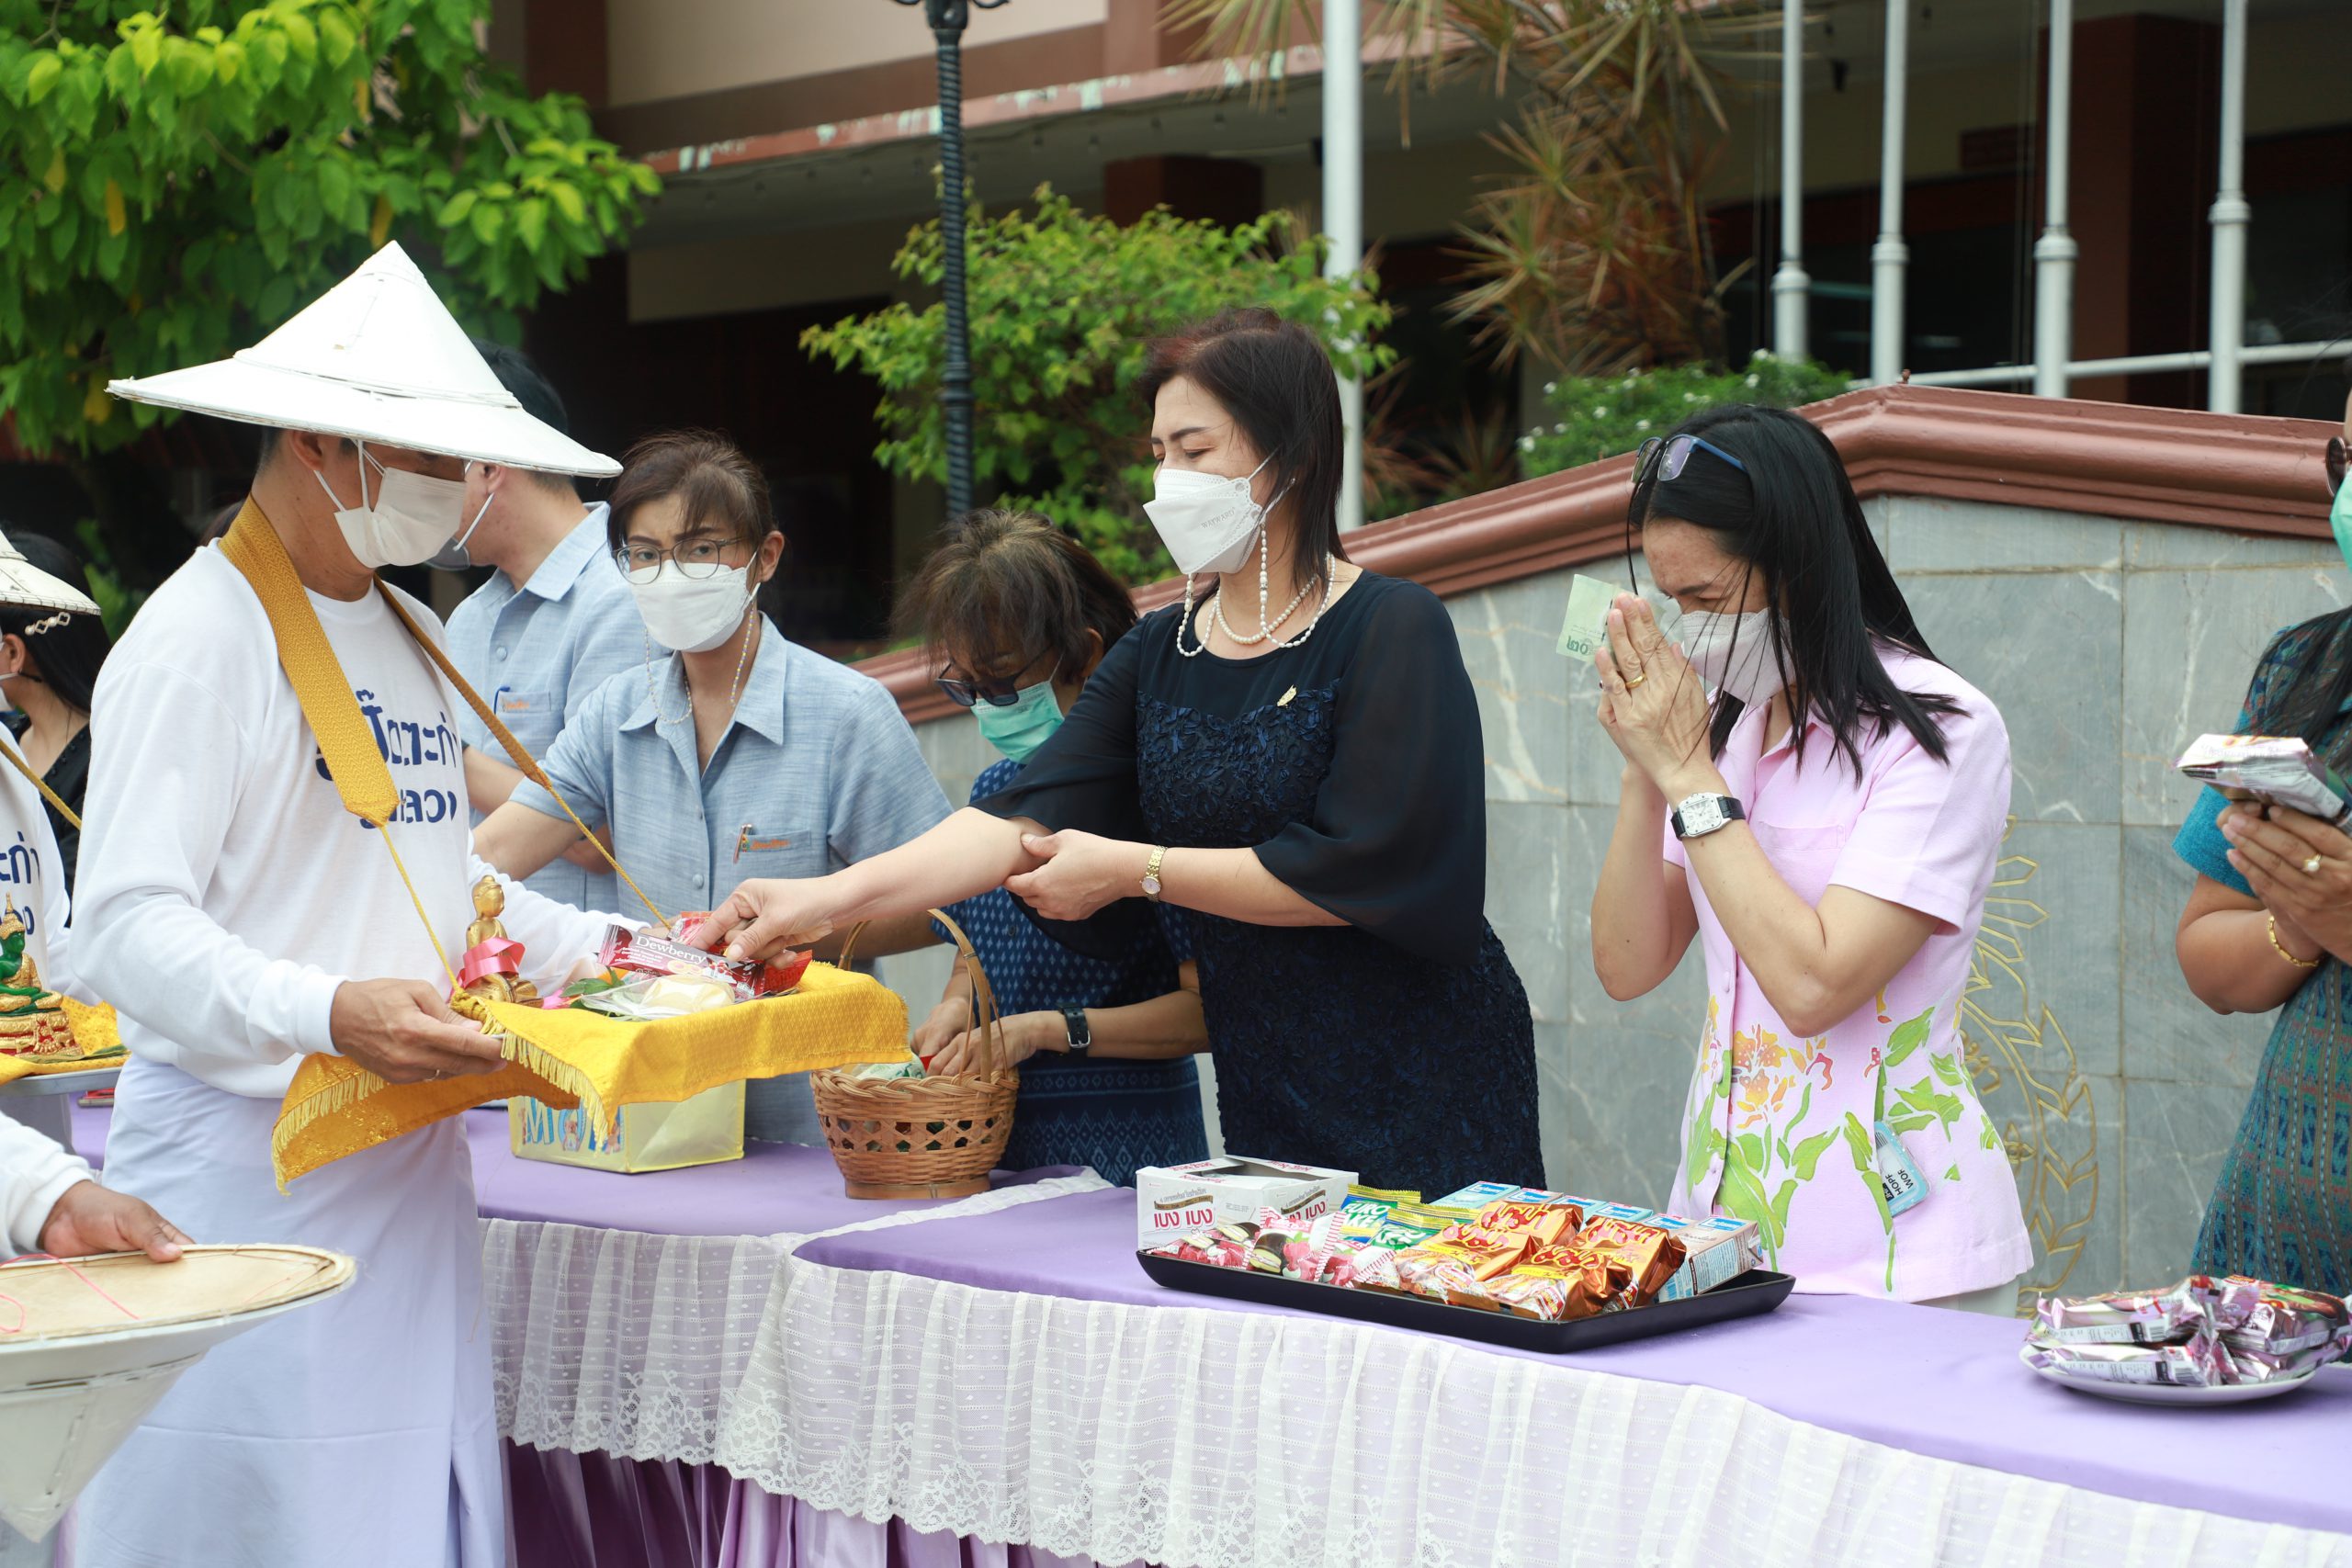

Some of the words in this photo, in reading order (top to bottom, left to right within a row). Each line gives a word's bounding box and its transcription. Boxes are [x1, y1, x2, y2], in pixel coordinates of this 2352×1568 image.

[1201, 508, 1235, 529] WAYWARD
[636, 935, 707, 964] Dewberry
[1154, 1211, 1181, 1228] เบง
[1185, 1208, 1214, 1225] เบง
[1342, 1213, 1379, 1227] AKE
